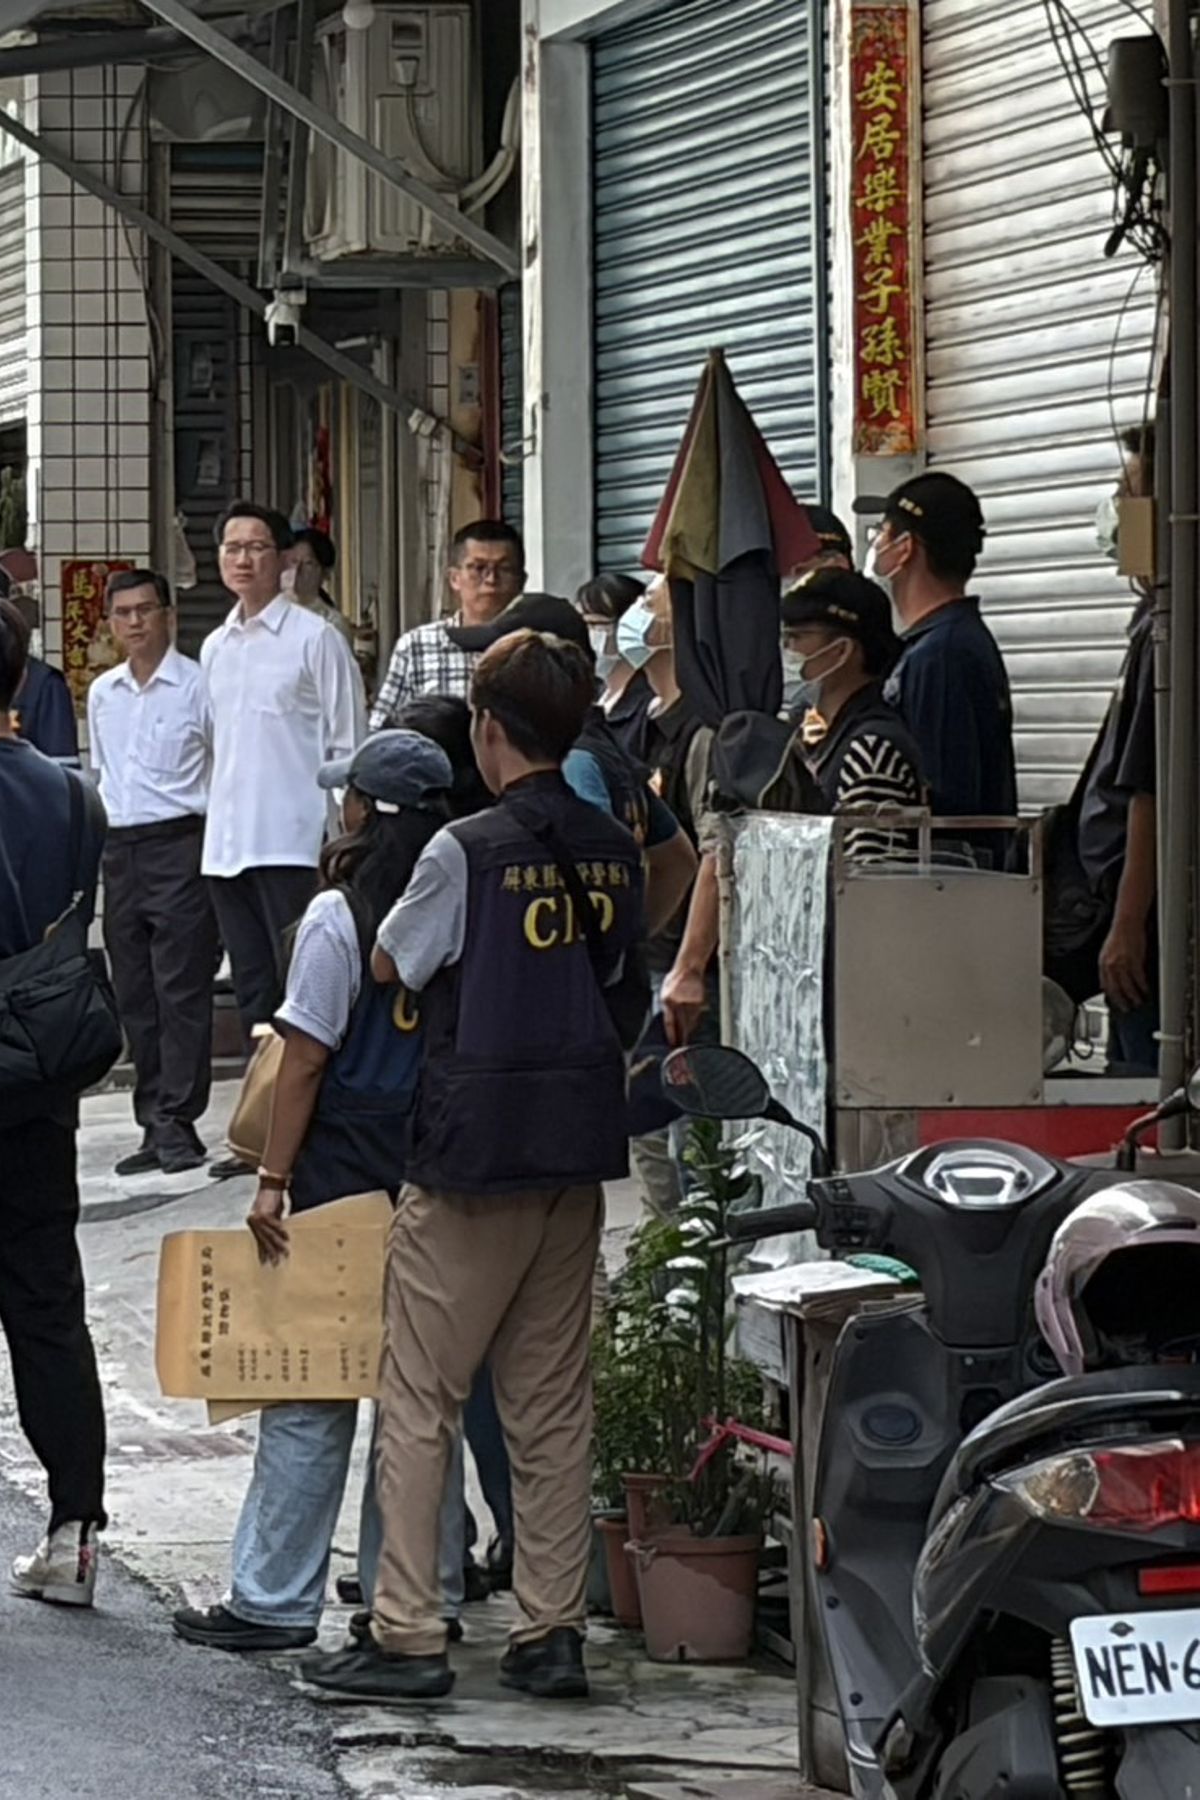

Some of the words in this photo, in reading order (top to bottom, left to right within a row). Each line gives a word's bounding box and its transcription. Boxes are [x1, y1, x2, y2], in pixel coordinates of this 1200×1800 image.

[856, 61, 905, 418] 安居樂業子孫賢
